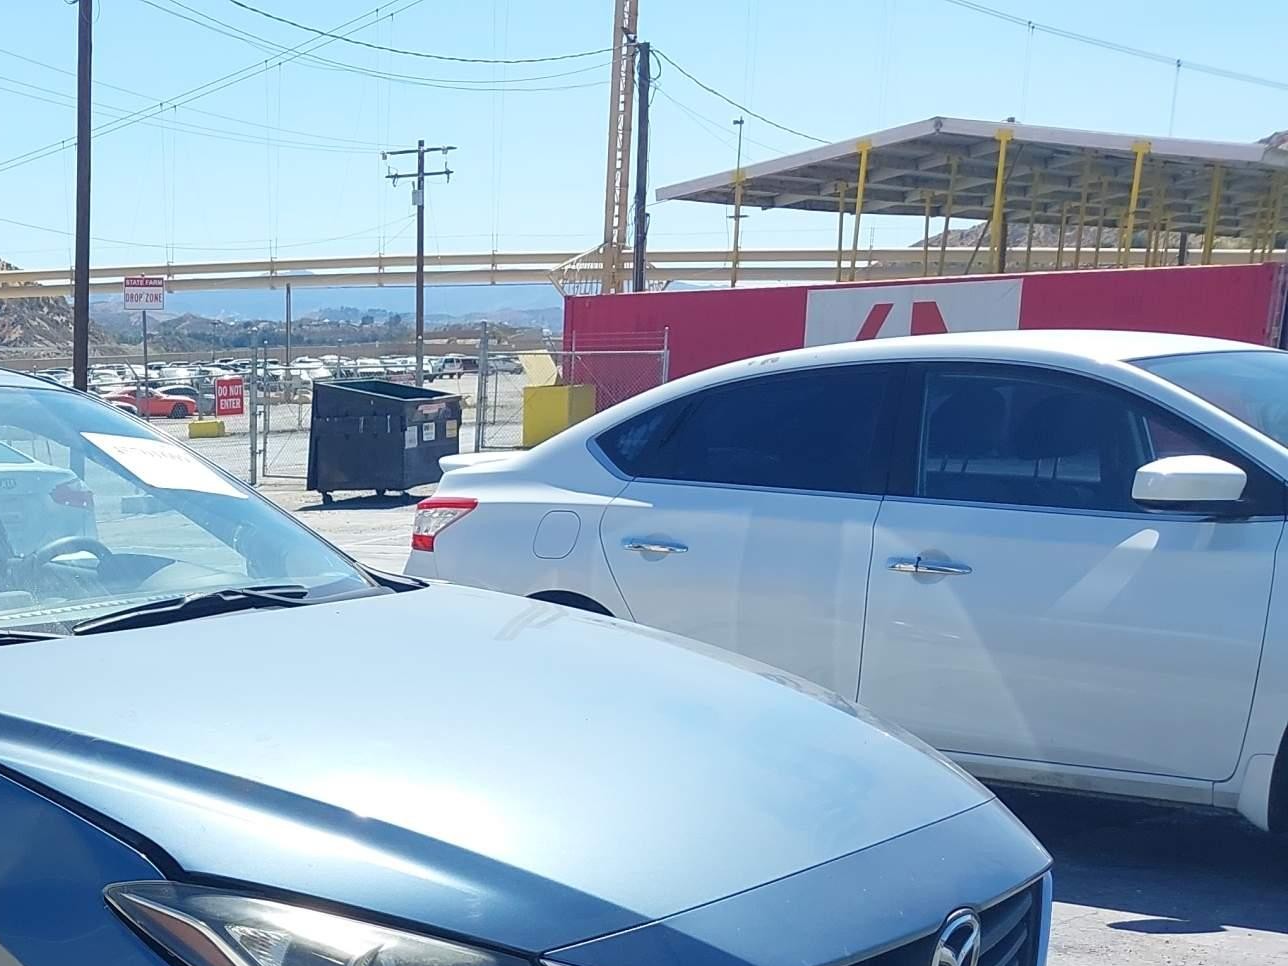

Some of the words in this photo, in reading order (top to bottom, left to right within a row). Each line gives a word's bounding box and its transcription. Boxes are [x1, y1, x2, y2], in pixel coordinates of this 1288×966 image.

[125, 293, 144, 303] DROP
[145, 293, 162, 303] ZONE
[218, 385, 228, 396] DO
[229, 384, 242, 395] NOT
[220, 398, 241, 410] ENTER
